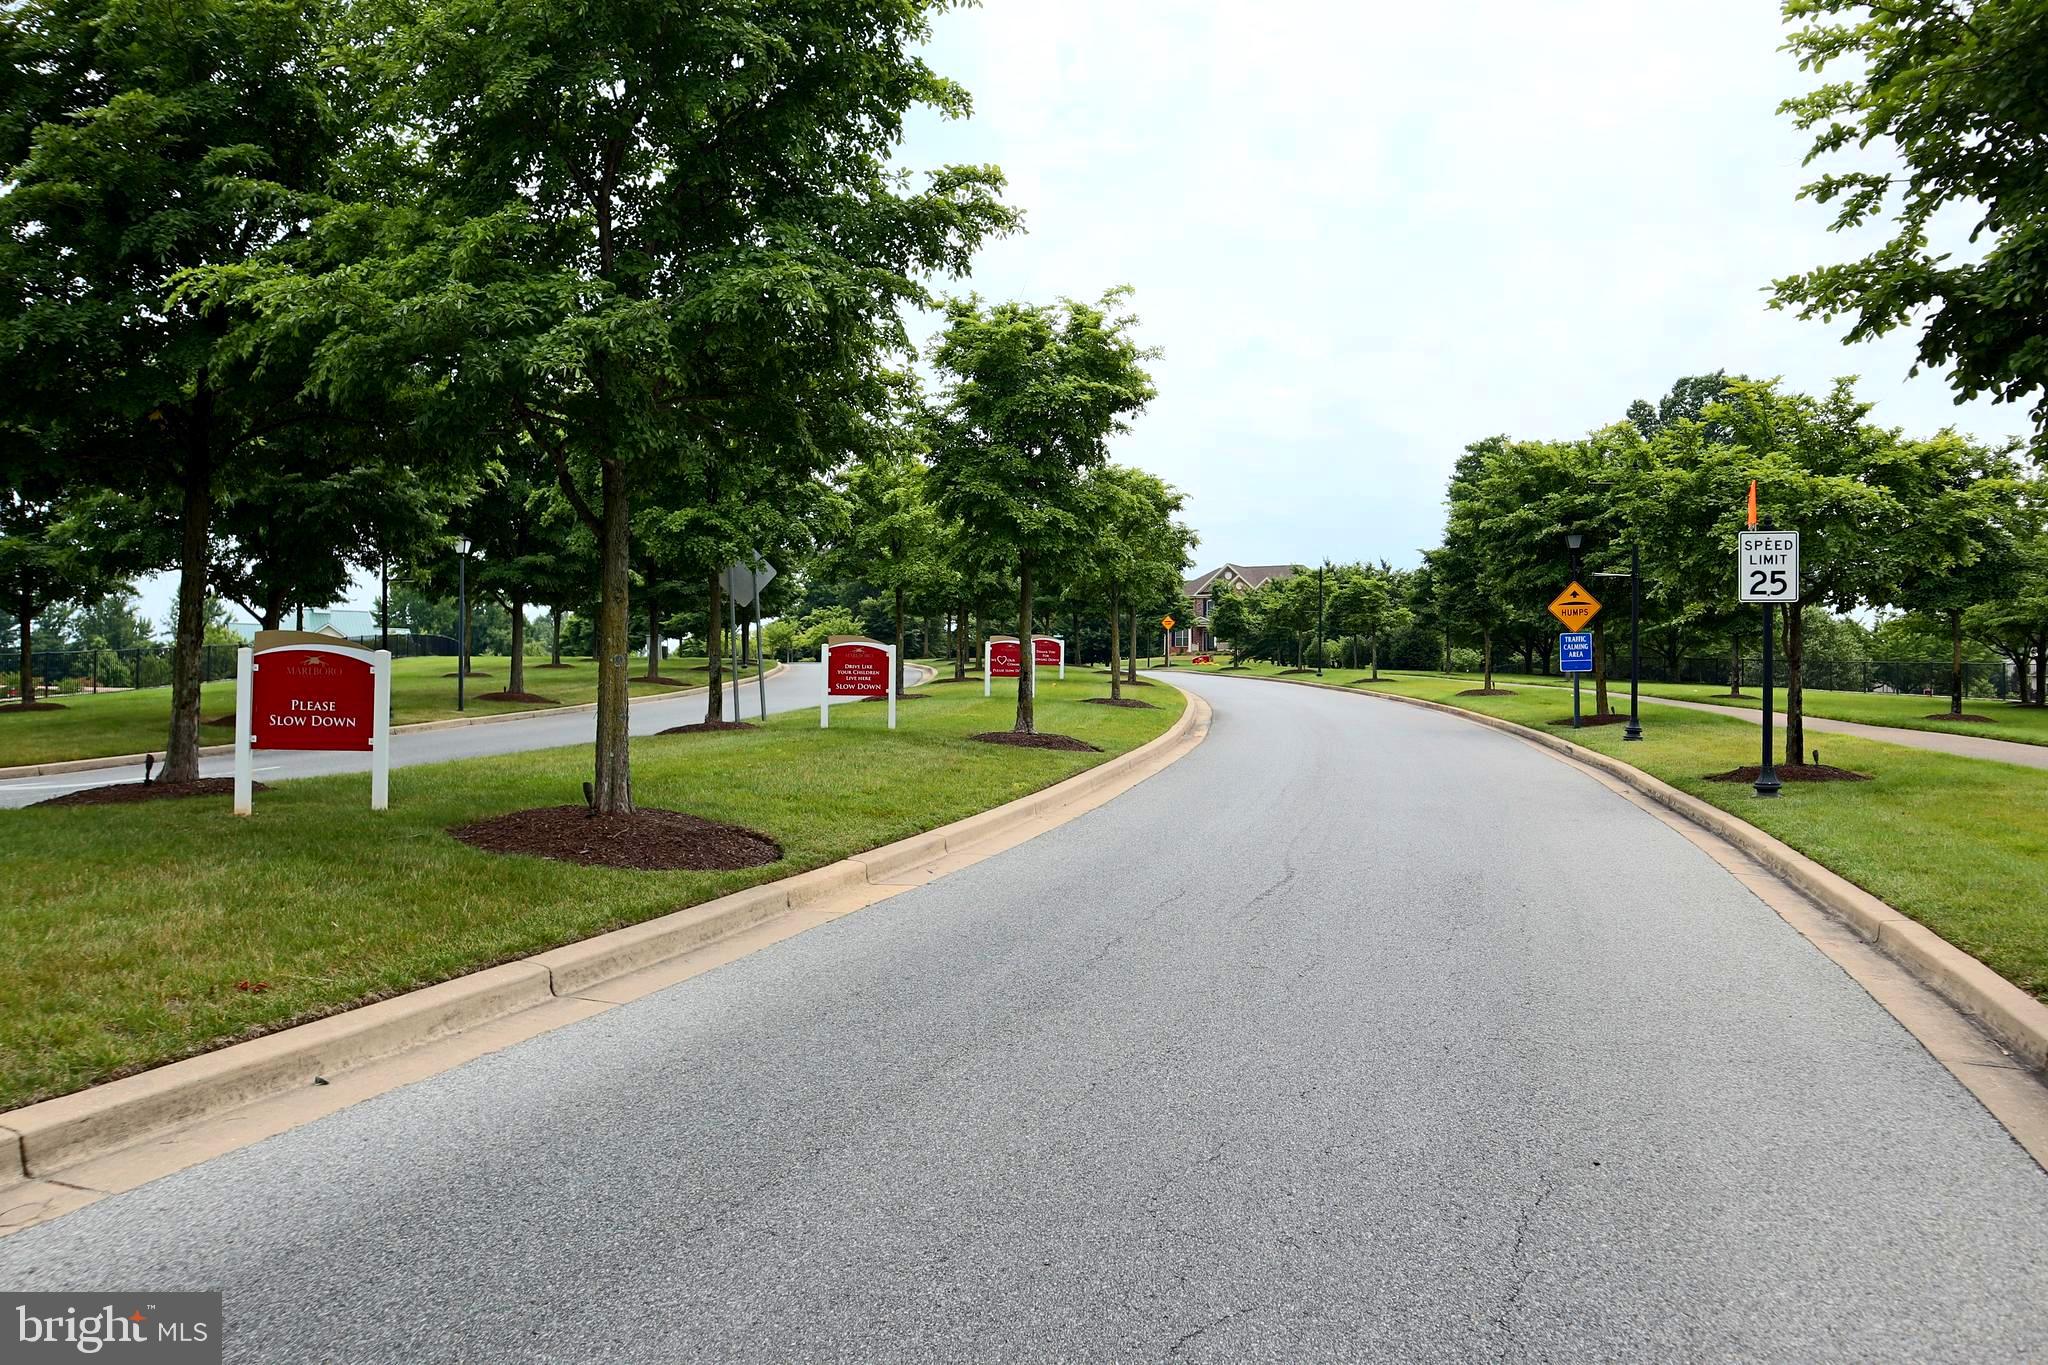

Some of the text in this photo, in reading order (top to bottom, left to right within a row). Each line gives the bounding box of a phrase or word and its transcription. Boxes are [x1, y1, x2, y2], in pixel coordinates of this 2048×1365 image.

[1744, 540, 1793, 551] SPEED
[1749, 554, 1788, 565] LIMIT
[1749, 570, 1788, 596] 25
[1561, 608, 1589, 617] HUMPS
[1564, 635, 1587, 643] TRAFFIC
[1563, 643, 1589, 651] CALMING
[291, 699, 336, 711] PLEASE
[269, 714, 356, 727] SLOW DOWN
